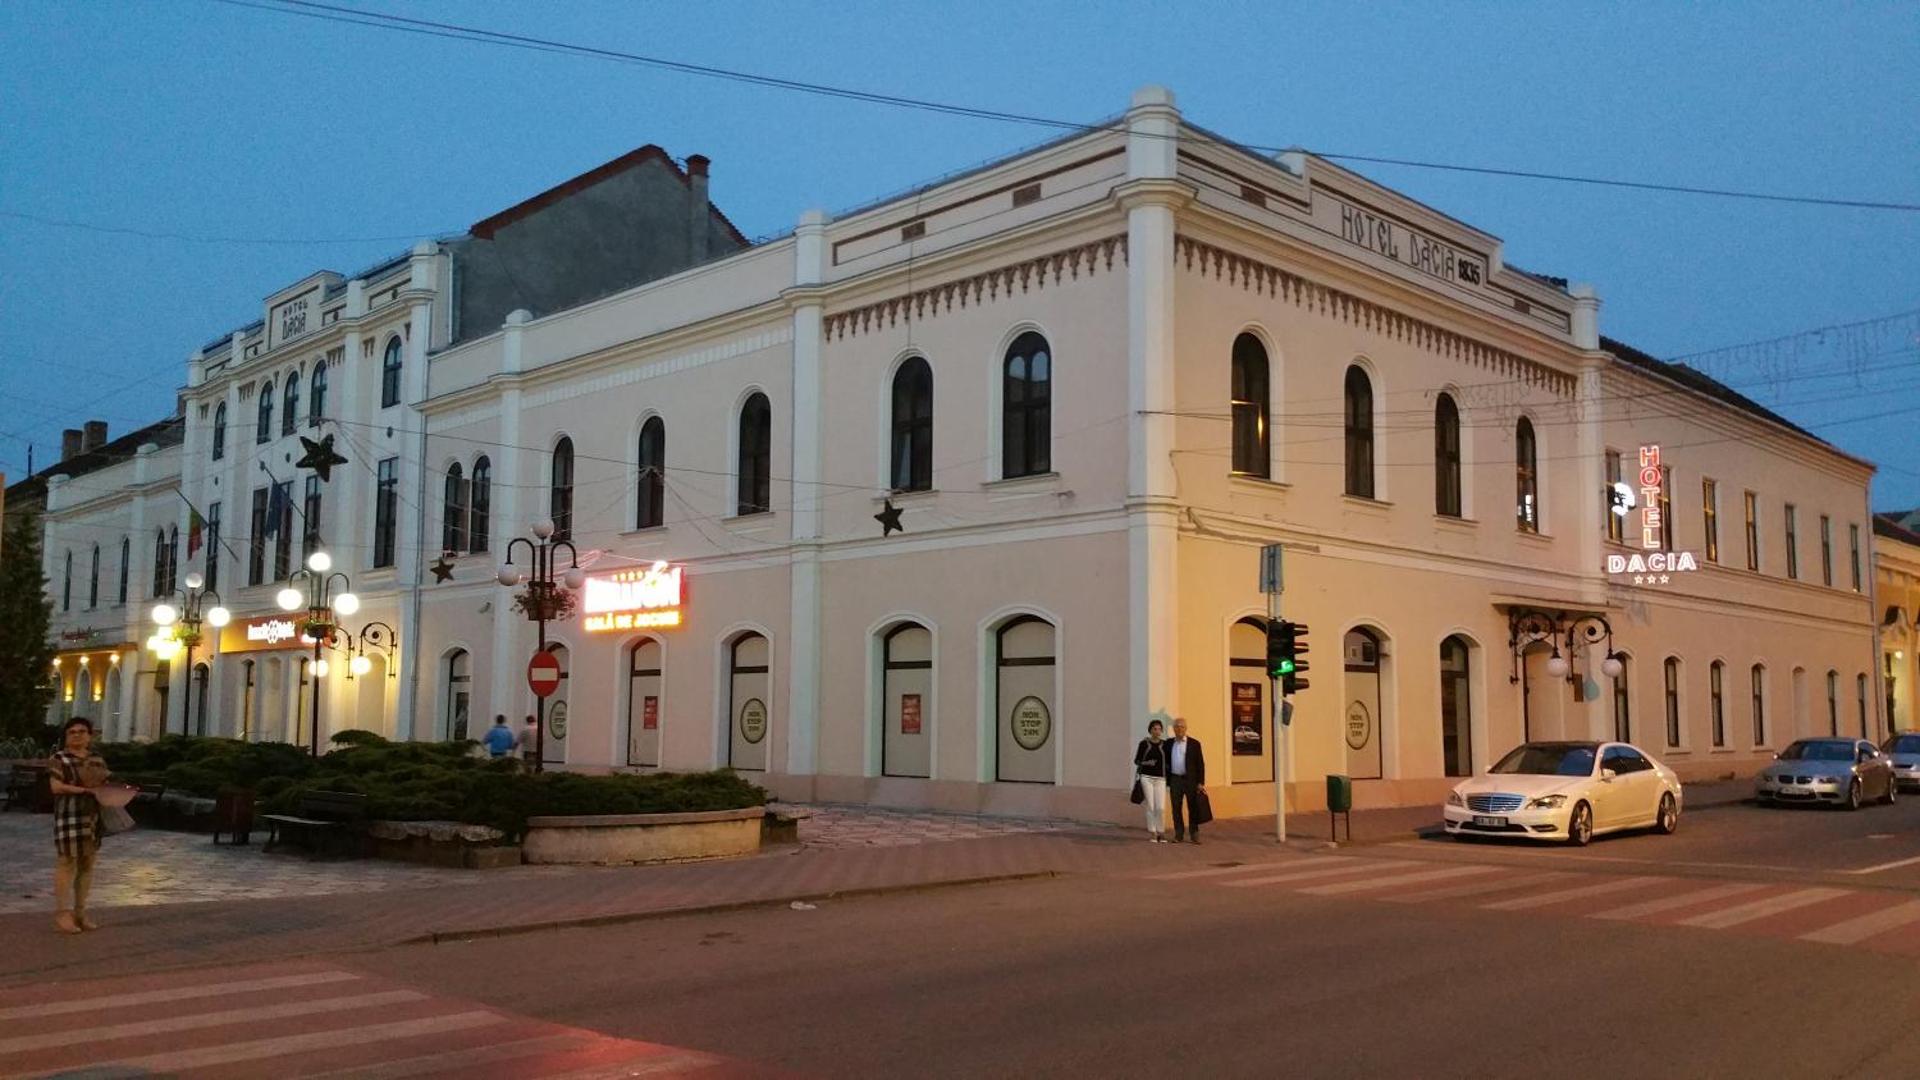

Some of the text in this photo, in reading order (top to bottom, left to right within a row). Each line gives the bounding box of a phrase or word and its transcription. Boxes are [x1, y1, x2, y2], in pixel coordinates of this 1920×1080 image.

[1342, 205, 1399, 260] HOTEL
[1640, 445, 1661, 549] HOTEL
[1608, 552, 1697, 573] DACIA
[1020, 720, 1041, 728] STOP
